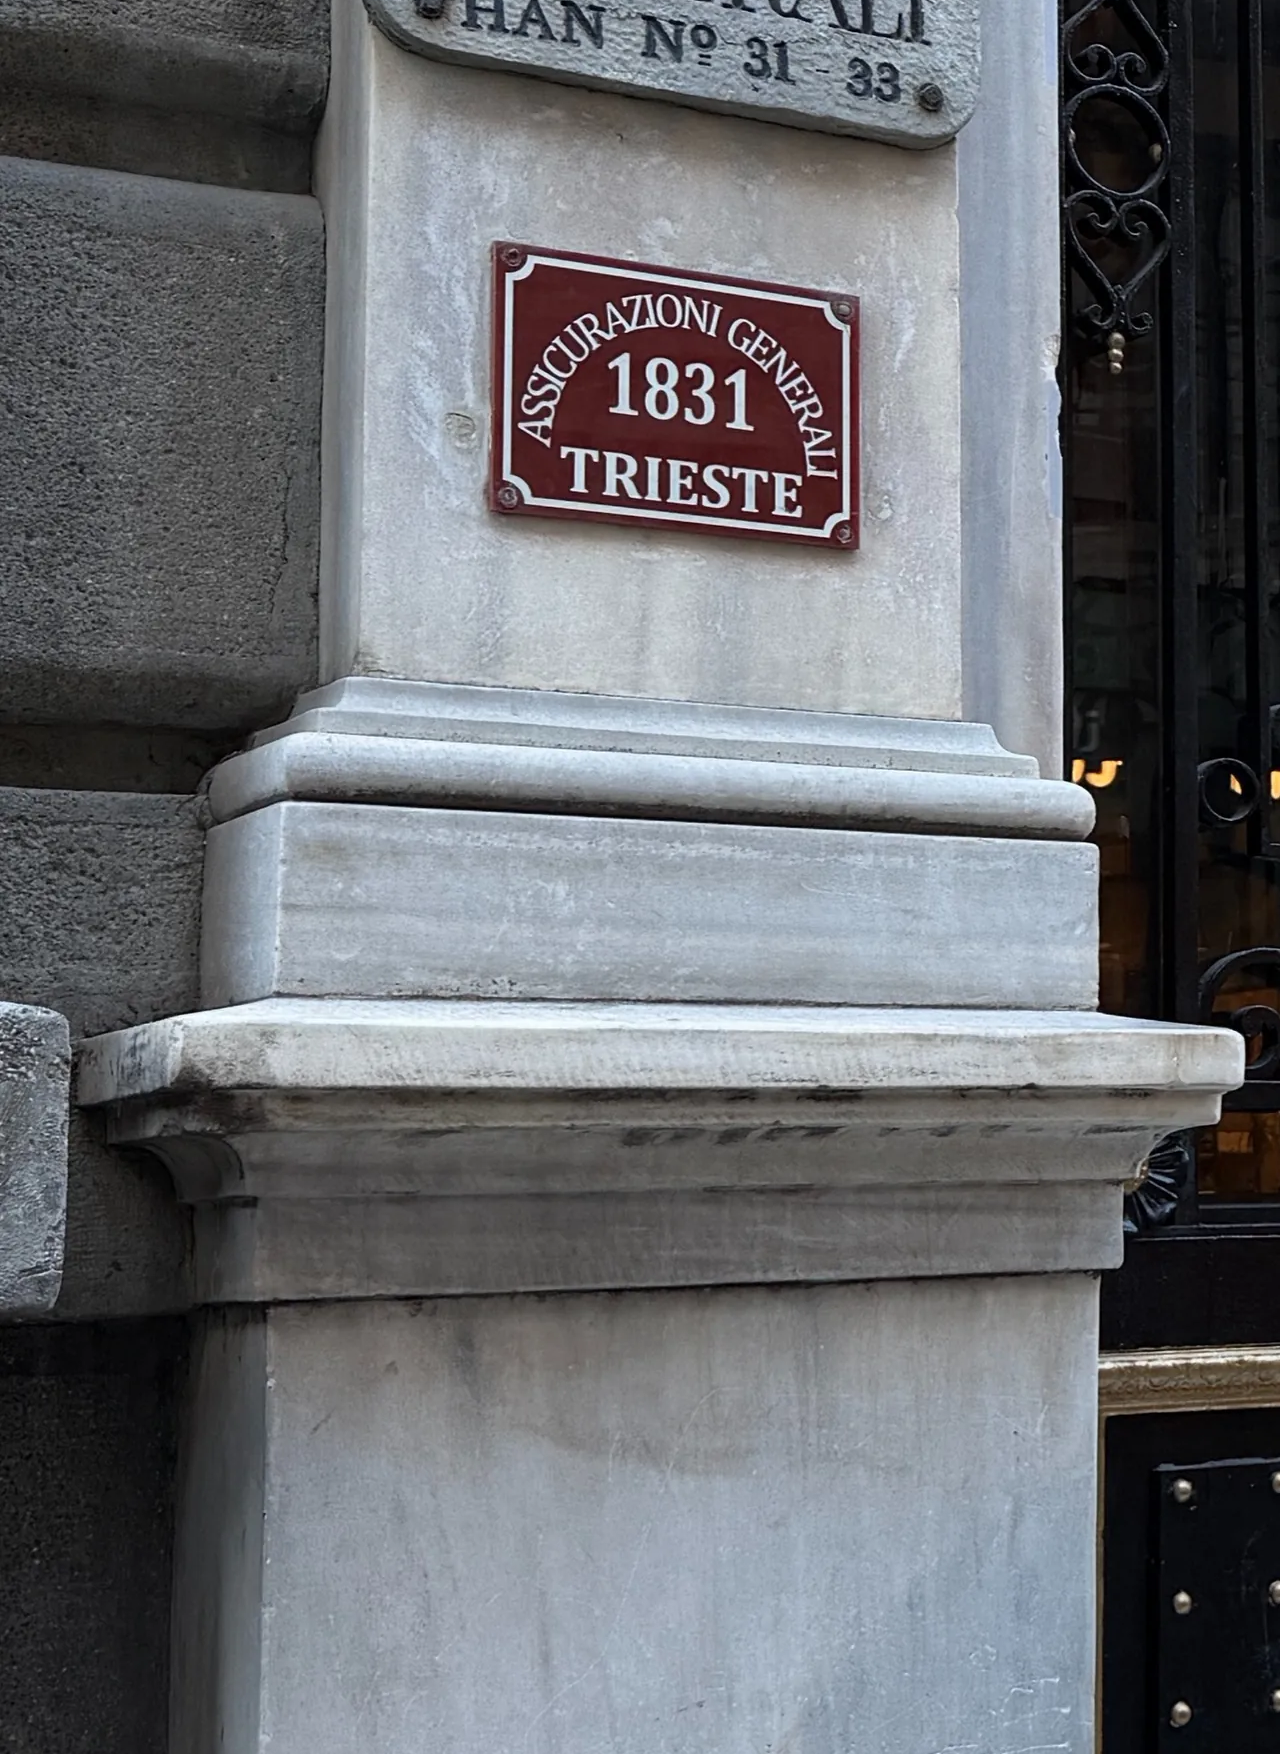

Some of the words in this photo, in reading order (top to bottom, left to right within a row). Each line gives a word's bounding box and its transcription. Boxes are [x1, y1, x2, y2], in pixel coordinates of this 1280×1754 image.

[517, 293, 724, 448] ASSICURAZIONI
[727, 318, 838, 480] GENERALI
[607, 351, 755, 432] 1831
[560, 445, 803, 518] TRIESTE
